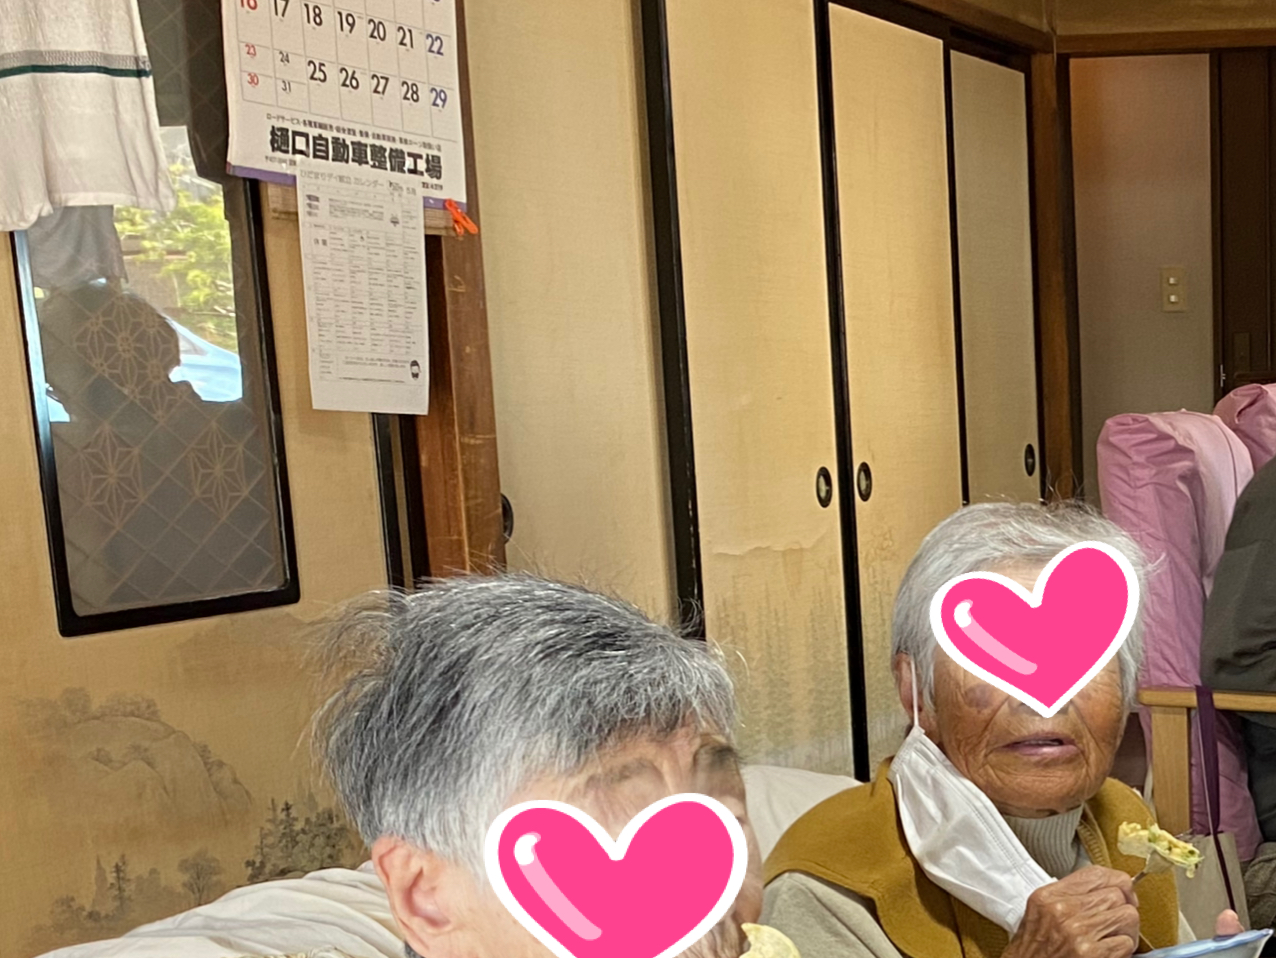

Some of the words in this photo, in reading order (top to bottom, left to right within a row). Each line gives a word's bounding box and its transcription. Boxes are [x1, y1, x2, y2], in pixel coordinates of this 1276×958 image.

[273, 0, 290, 18] 17
[304, 3, 323, 27] 18
[337, 10, 356, 34] 19
[368, 18, 387, 42] 20
[397, 26, 414, 49] 21
[425, 33, 445, 56] 22
[245, 43, 257, 57] 23
[279, 50, 290, 64] 24
[307, 60, 328, 83] 25
[339, 67, 360, 90] 26
[371, 74, 390, 96] 27
[401, 81, 420, 103] 28
[430, 87, 448, 109] 29
[247, 73, 259, 86] 30
[281, 80, 292, 93] 31
[269, 125, 443, 180] 樋口自動車整備工場
